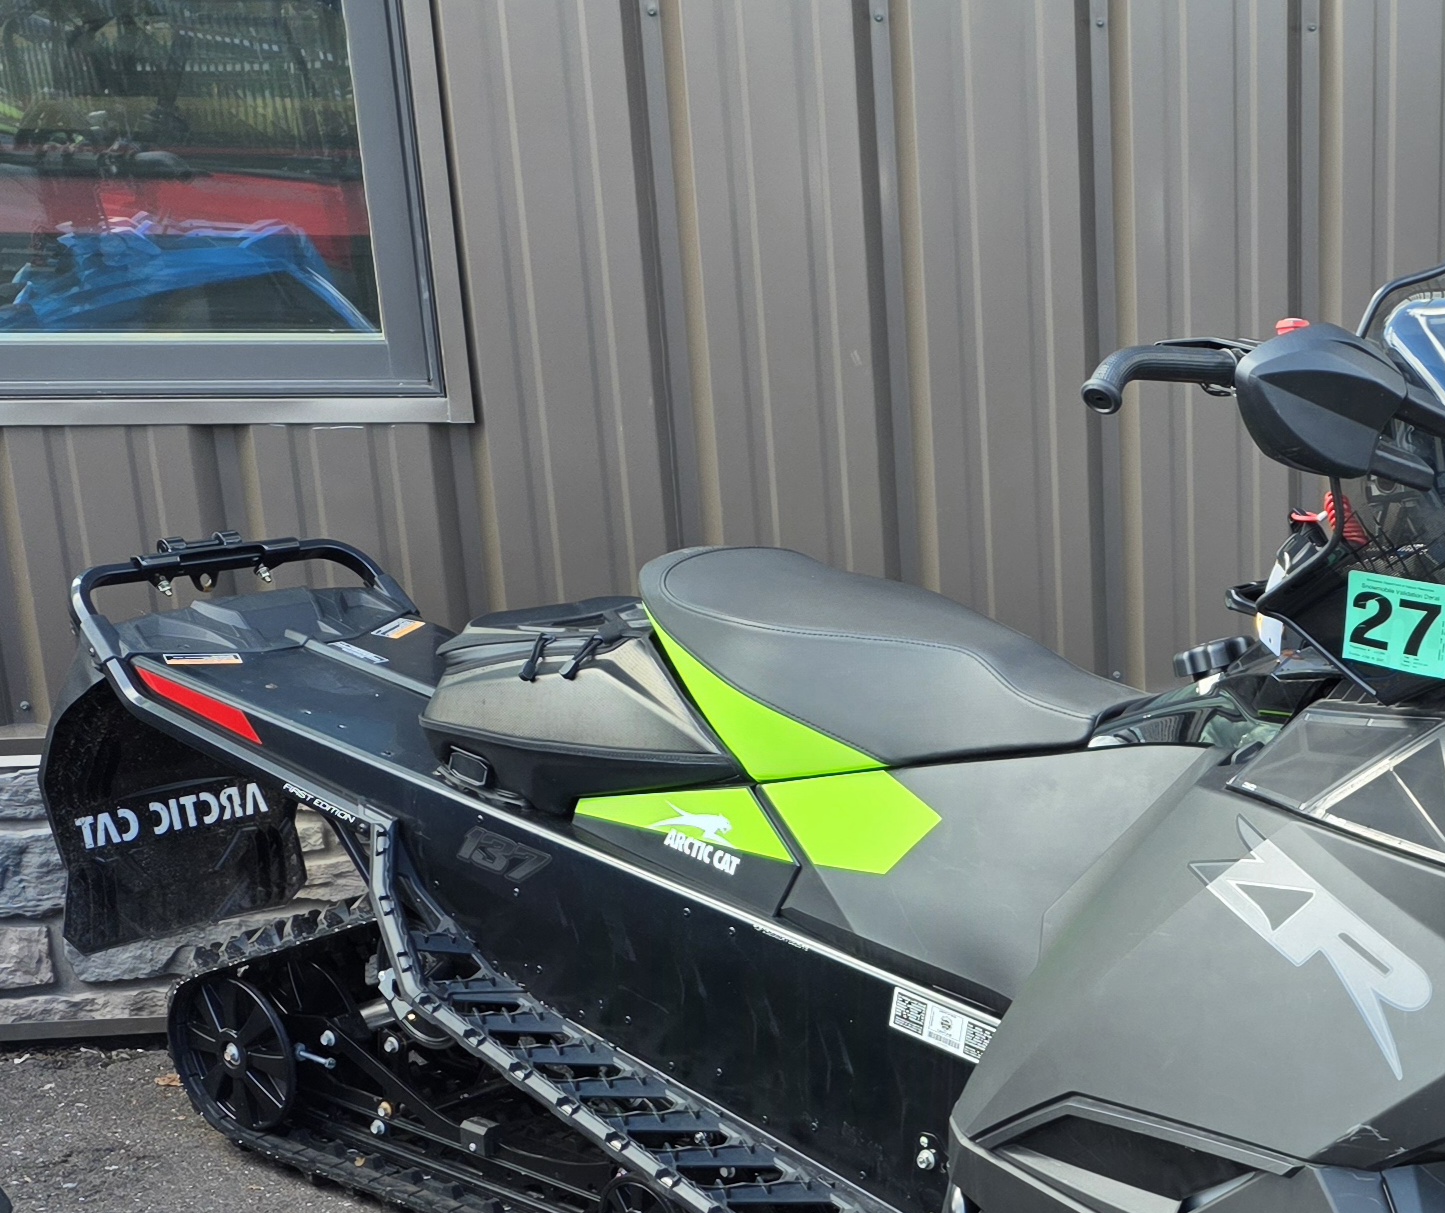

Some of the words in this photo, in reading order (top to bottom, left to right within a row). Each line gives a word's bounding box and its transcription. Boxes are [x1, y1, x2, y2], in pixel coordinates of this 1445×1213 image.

[1349, 591, 1442, 657] 27
[282, 783, 314, 801] FIRST
[313, 799, 356, 823] EDITION
[456, 826, 552, 883] 137
[663, 828, 714, 864] ARCTIC
[712, 849, 741, 876] CAT
